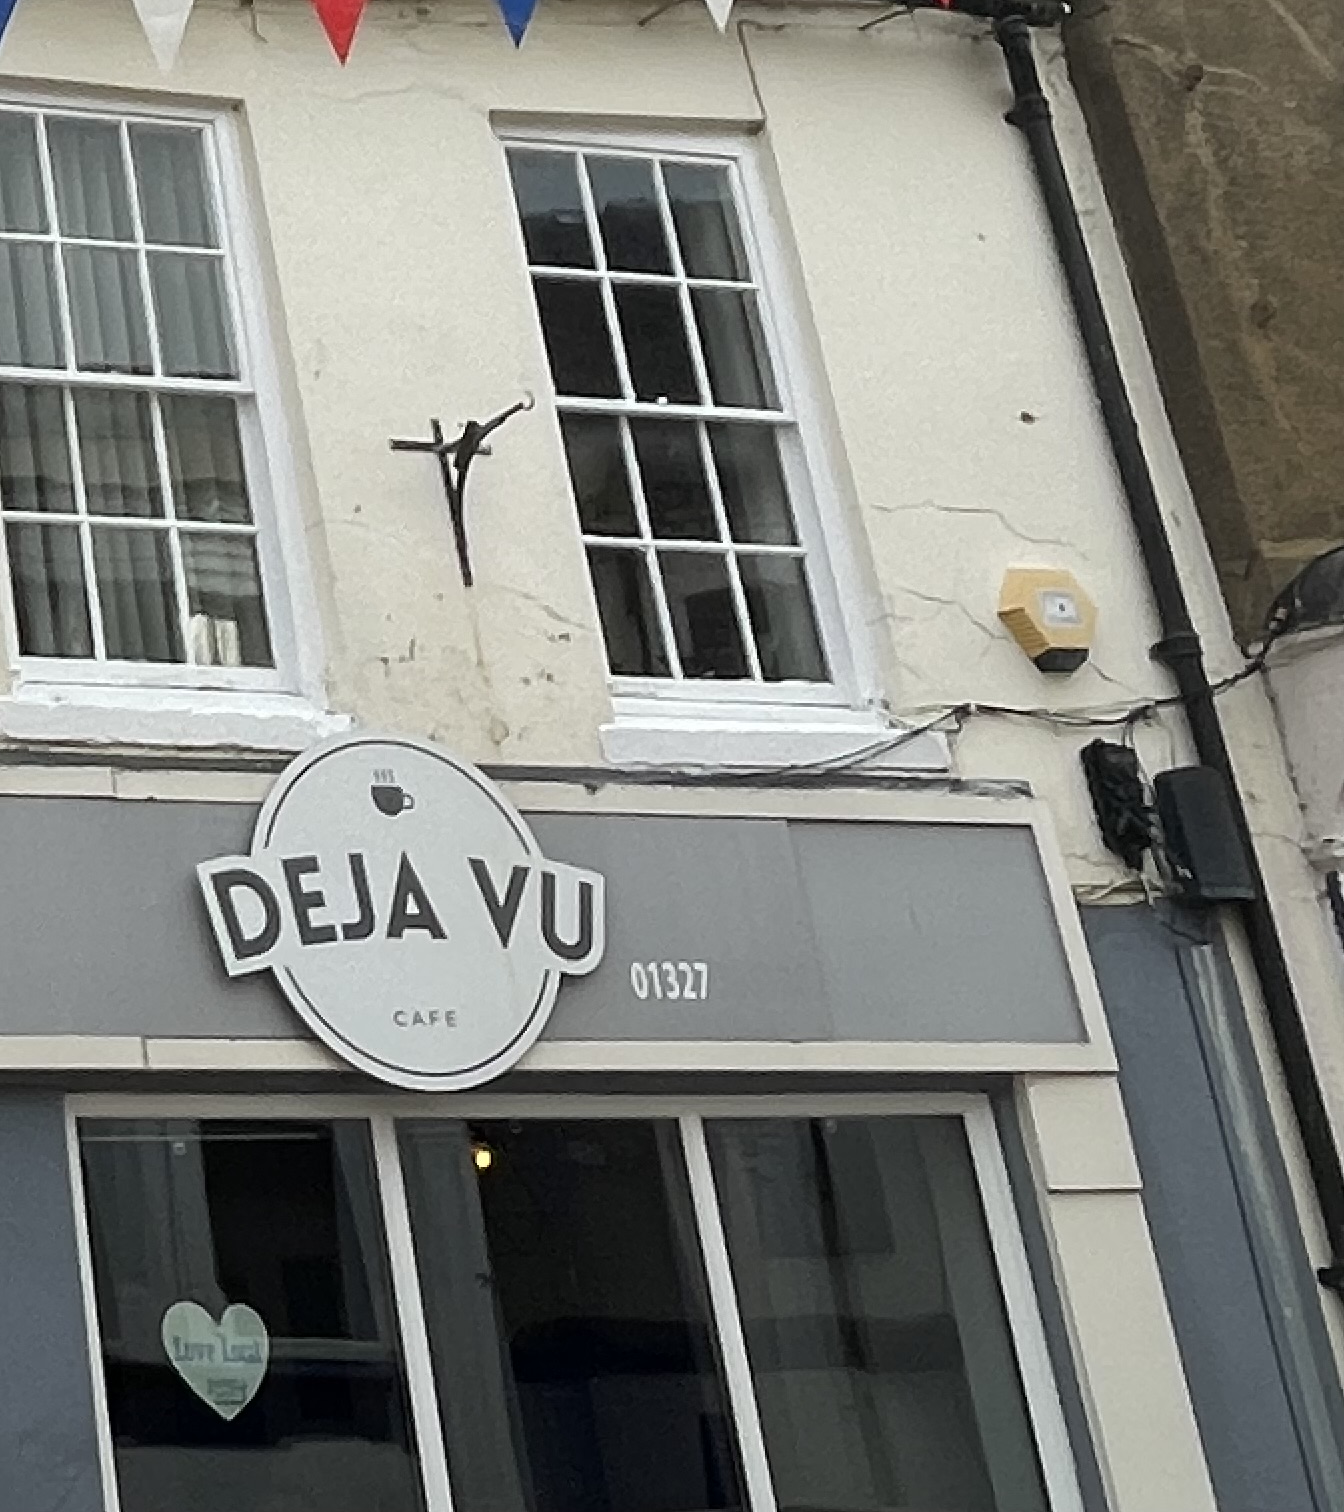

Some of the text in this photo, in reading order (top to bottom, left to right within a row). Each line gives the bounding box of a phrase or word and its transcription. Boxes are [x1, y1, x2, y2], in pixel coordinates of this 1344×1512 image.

[210, 851, 593, 961] DEJA VU
[630, 961, 708, 1000] 01327
[393, 1009, 457, 1027] CAFE
